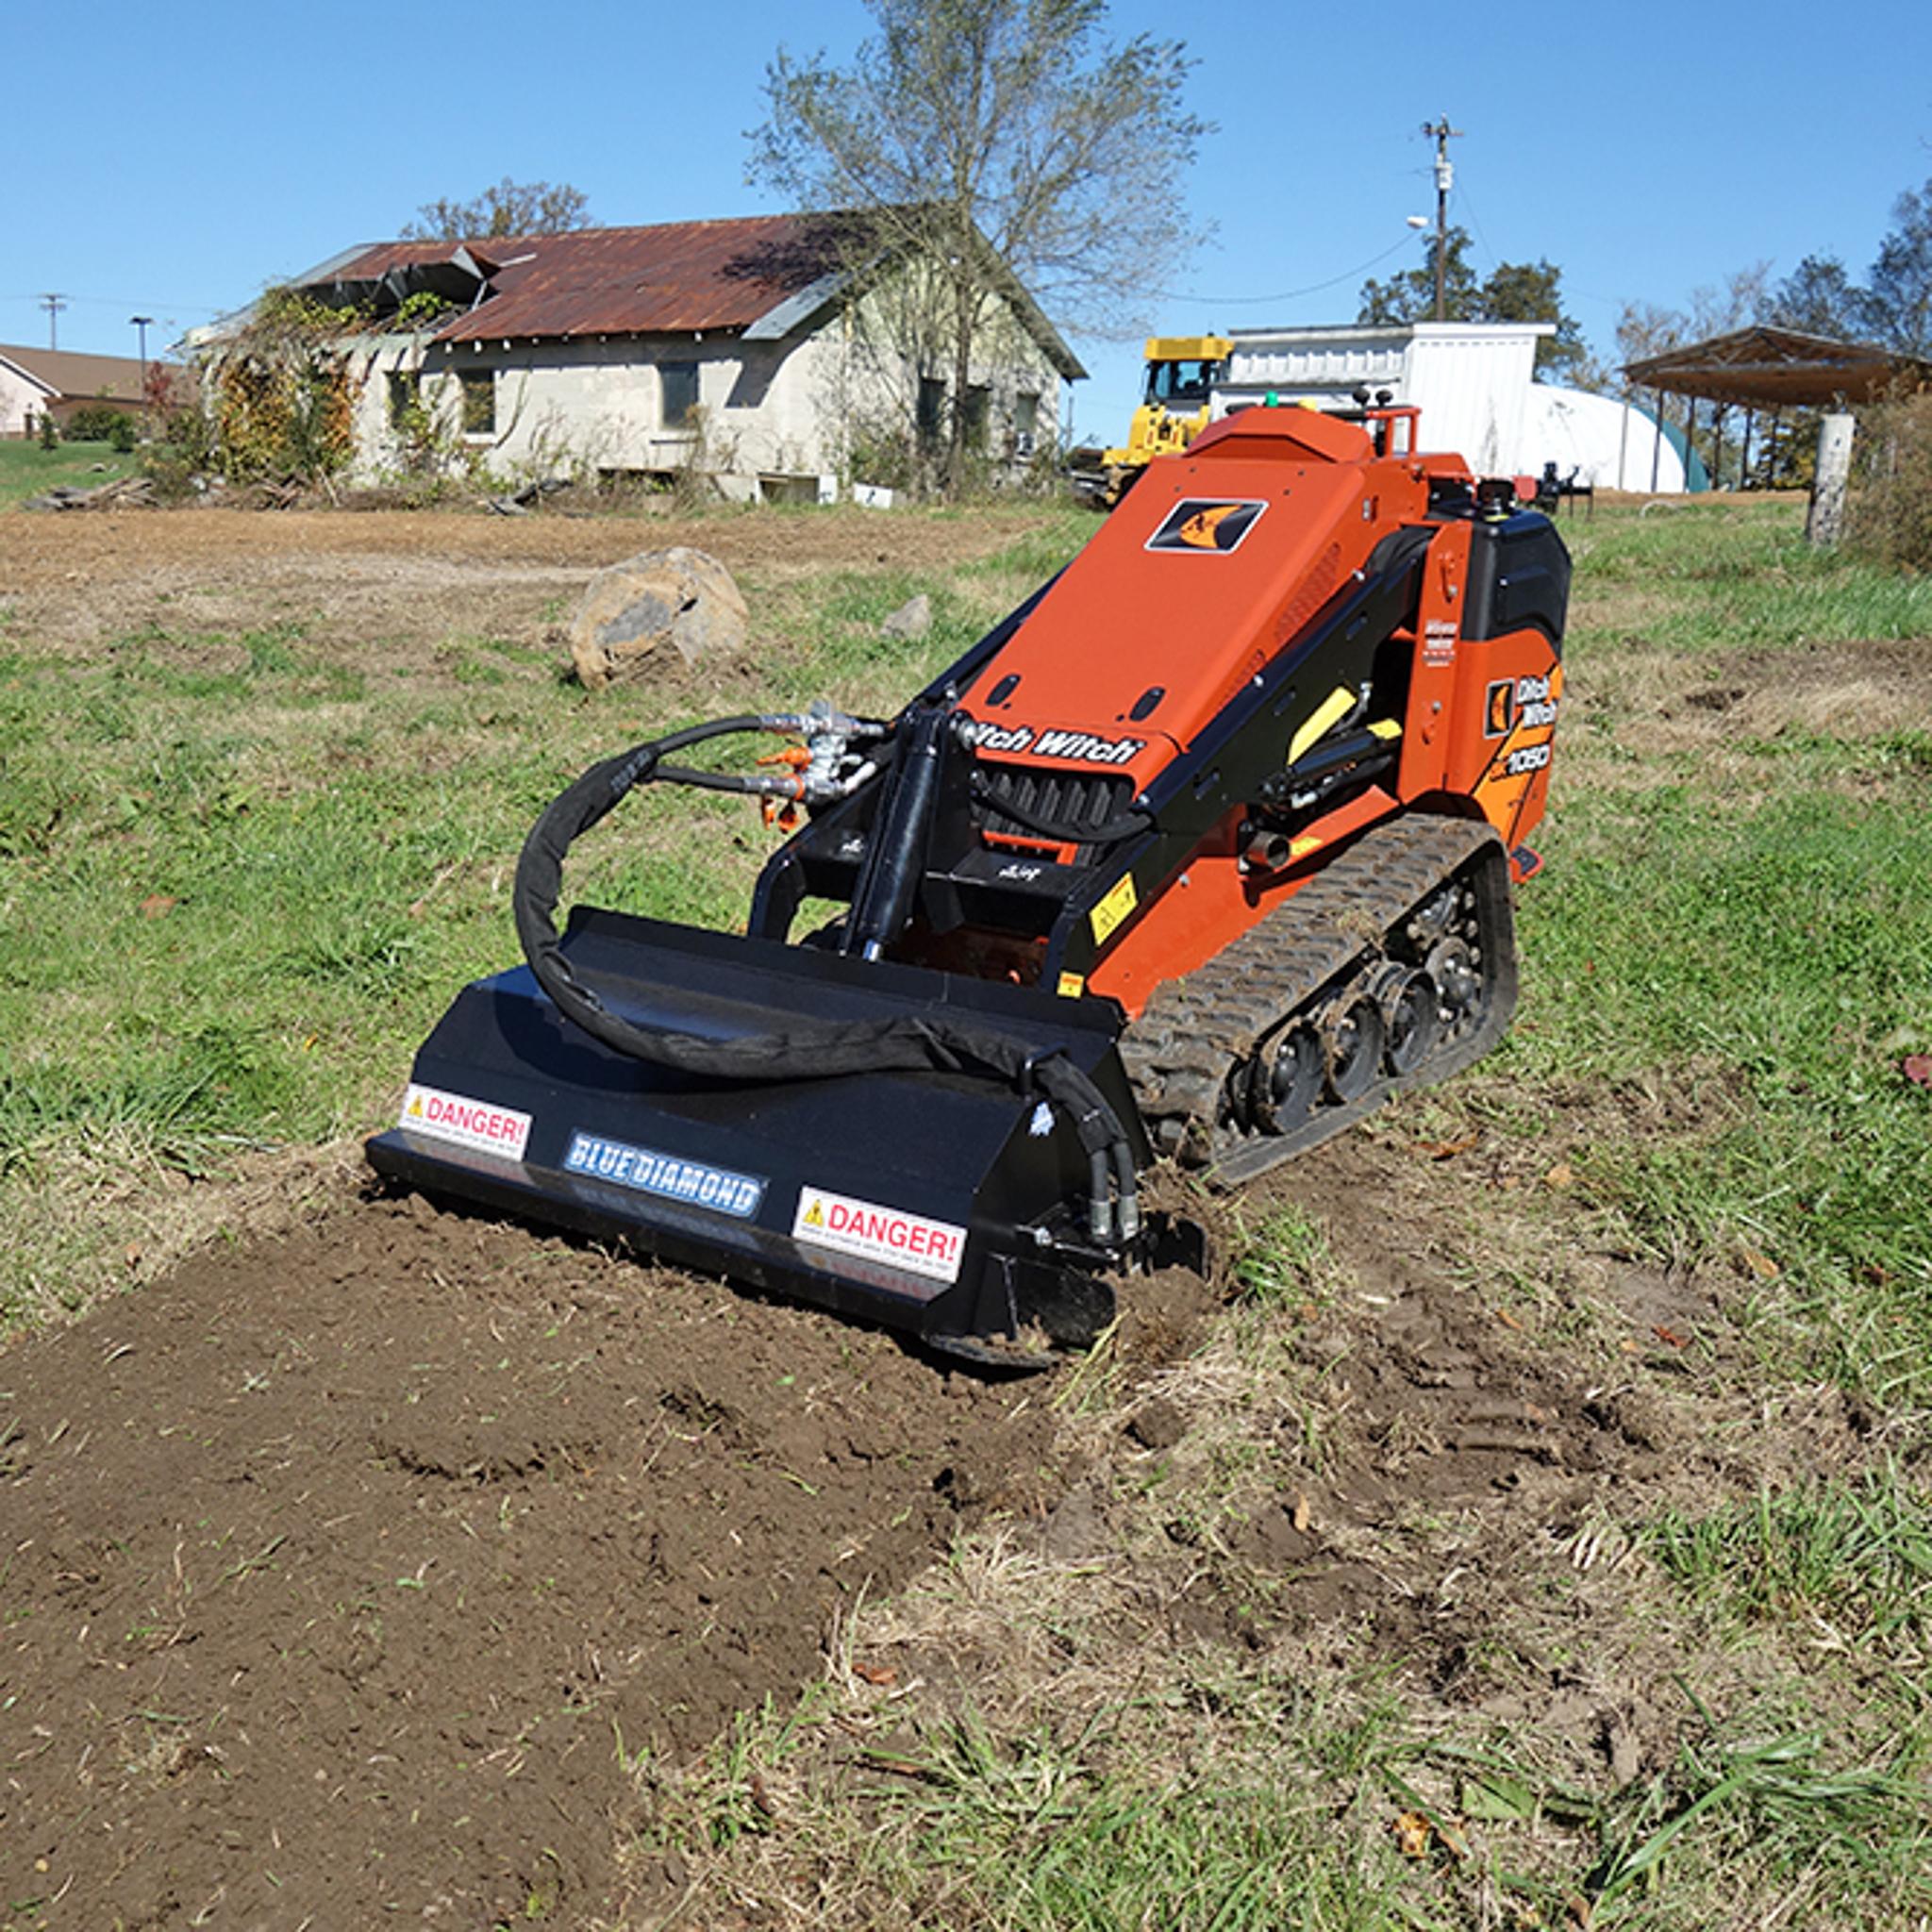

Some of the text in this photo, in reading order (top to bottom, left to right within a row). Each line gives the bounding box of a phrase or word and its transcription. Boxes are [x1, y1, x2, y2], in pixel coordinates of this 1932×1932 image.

[974, 723, 1138, 764] tch Witch
[426, 1097, 525, 1145] DANGER!
[569, 1139, 761, 1211] BLUE DIAMOND
[828, 1204, 958, 1262] DANGER!
